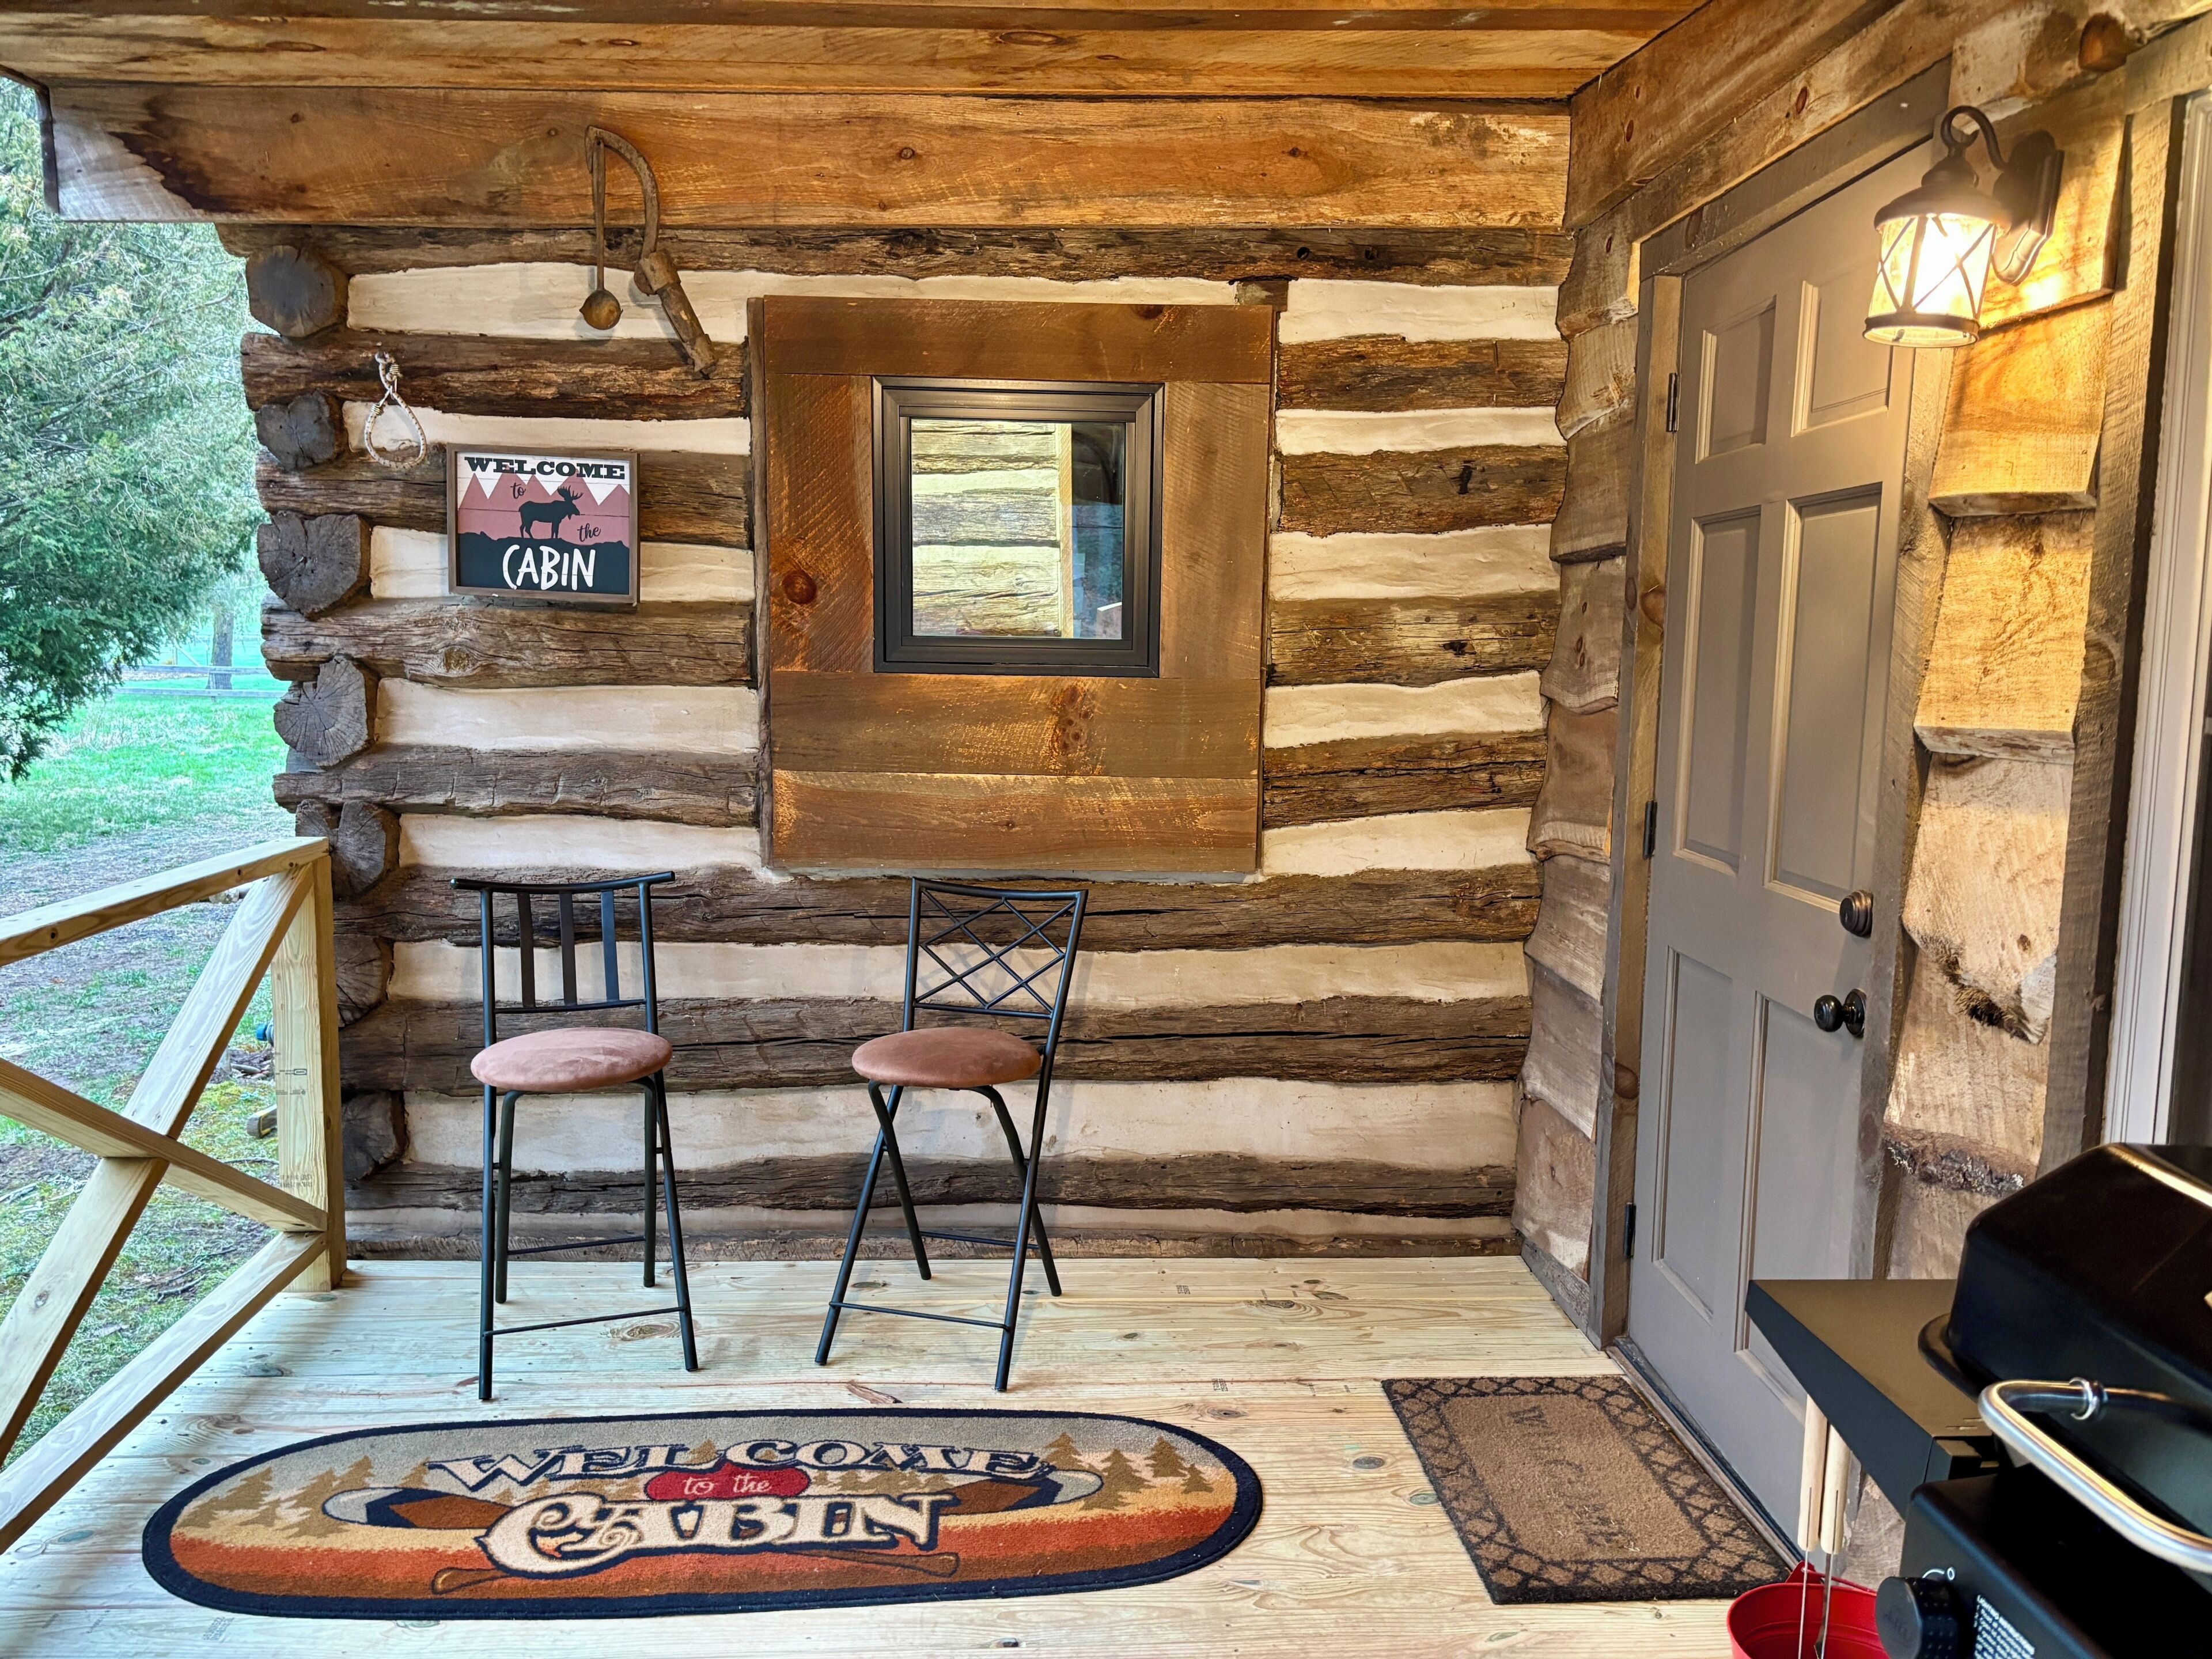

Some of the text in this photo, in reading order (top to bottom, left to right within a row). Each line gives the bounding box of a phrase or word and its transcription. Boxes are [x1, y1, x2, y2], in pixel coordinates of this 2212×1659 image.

[464, 457, 624, 479] WELCOME
[511, 483, 526, 499] to
[577, 523, 601, 541] the
[502, 544, 596, 590] CABIN
[424, 1440, 1053, 1492] WELCOME
[1507, 1406, 1639, 1550] WLCME
[683, 1474, 772, 1495] to the
[476, 1492, 957, 1579] CABIN
